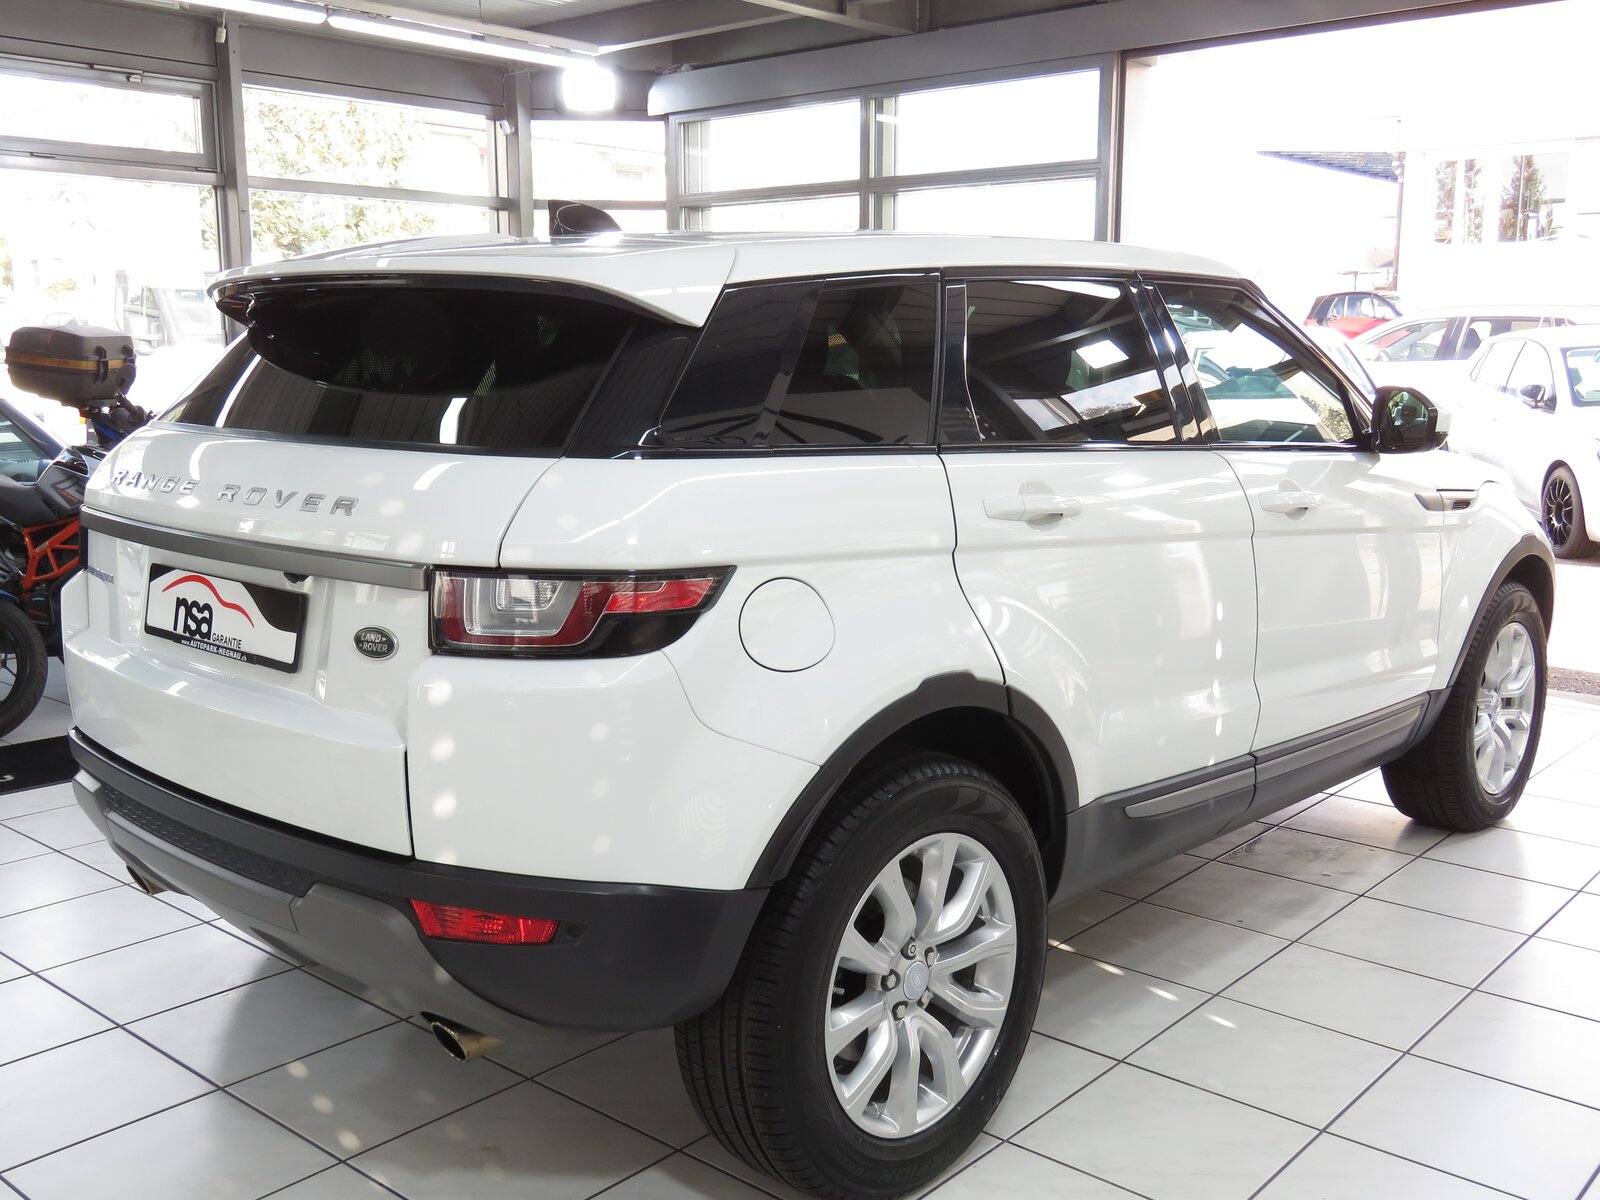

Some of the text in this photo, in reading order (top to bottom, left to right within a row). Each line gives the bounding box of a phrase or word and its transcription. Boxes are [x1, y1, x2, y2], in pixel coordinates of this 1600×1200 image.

[111, 469, 359, 516] RANGE ROVER
[173, 596, 213, 641] nsa
[212, 633, 242, 650] GARANTIE
